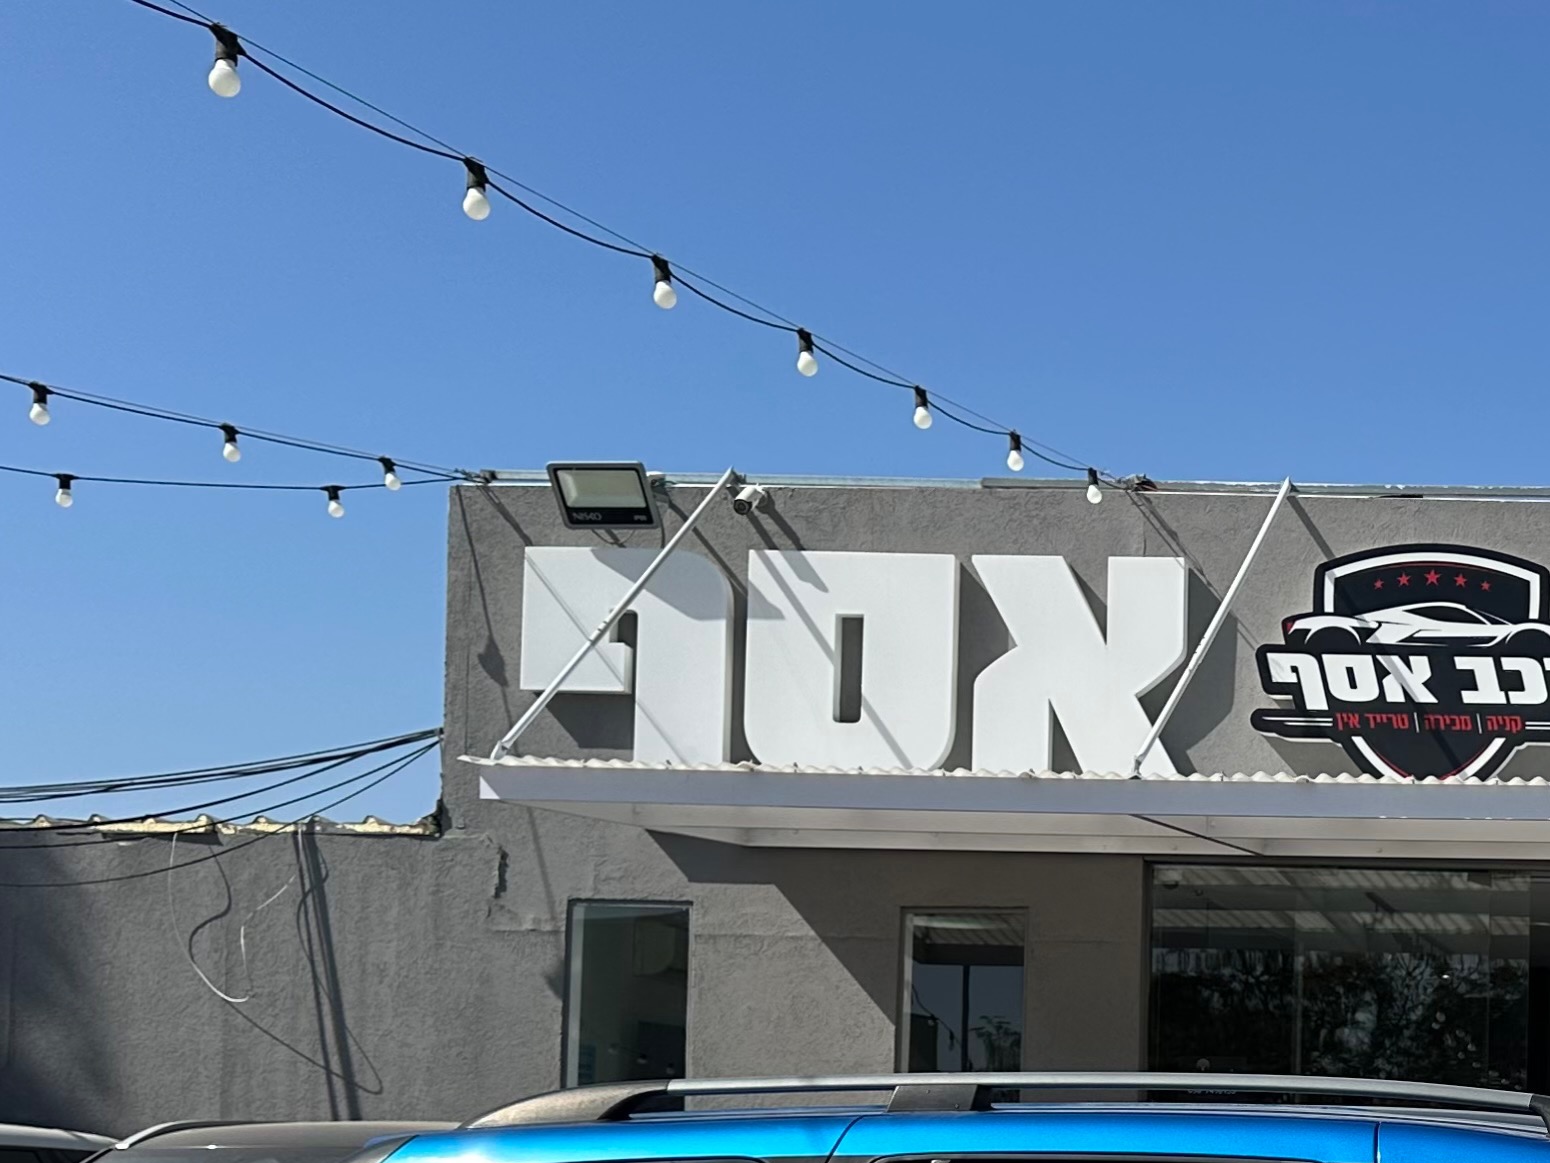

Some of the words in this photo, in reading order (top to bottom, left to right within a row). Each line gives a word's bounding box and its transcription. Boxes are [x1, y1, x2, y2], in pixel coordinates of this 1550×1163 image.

[519, 546, 1188, 775] אסף
[1265, 652, 1439, 711] אסף
[1335, 711, 1361, 732] אין
[1424, 714, 1473, 732] מכירה
[1486, 714, 1523, 734] קניה
